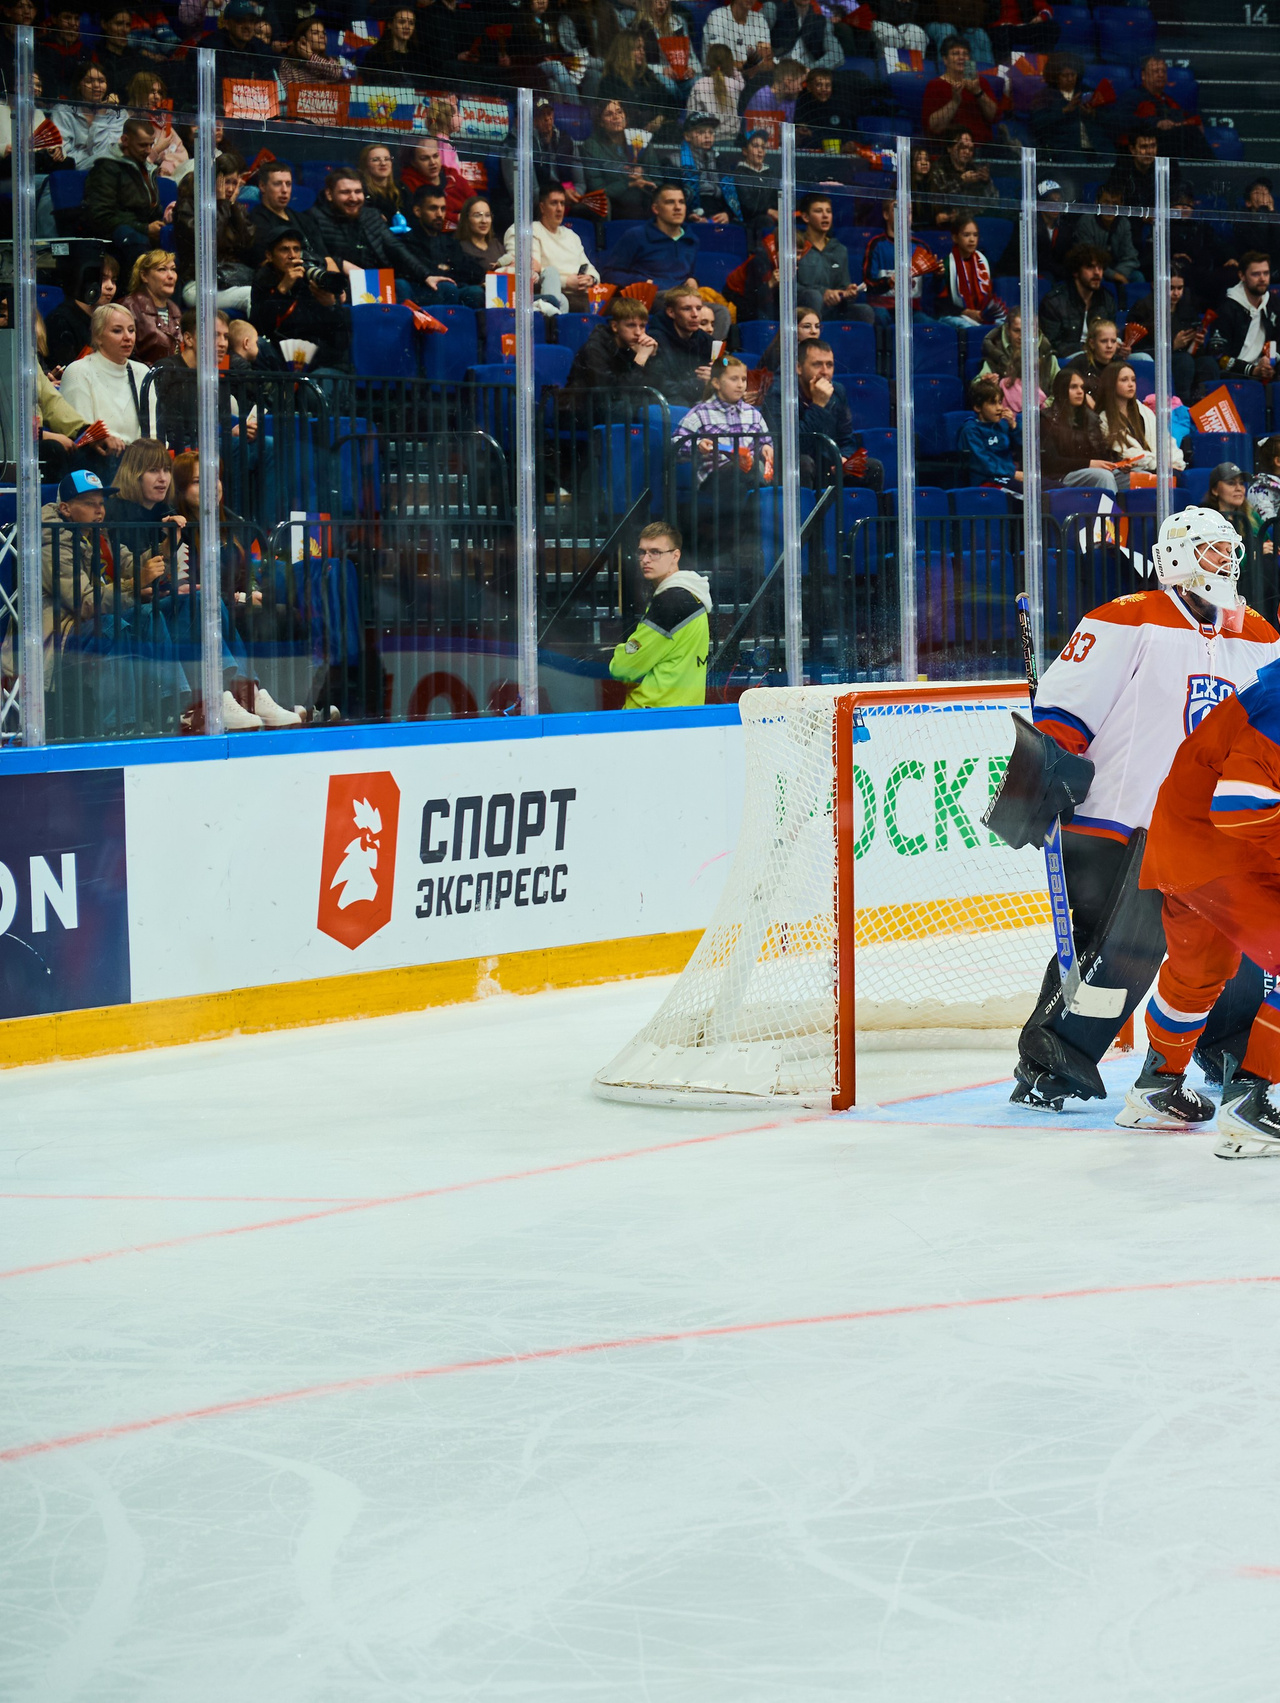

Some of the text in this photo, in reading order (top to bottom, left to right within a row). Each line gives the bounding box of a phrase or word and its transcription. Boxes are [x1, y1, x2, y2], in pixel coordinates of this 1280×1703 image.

[1242, 4, 1269, 25] 14
[1060, 631, 1097, 663] 83
[420, 788, 577, 864] СПОРТ
[415, 864, 569, 919] ЭКСПРЕСС
[1047, 852, 1071, 960] BAUER
